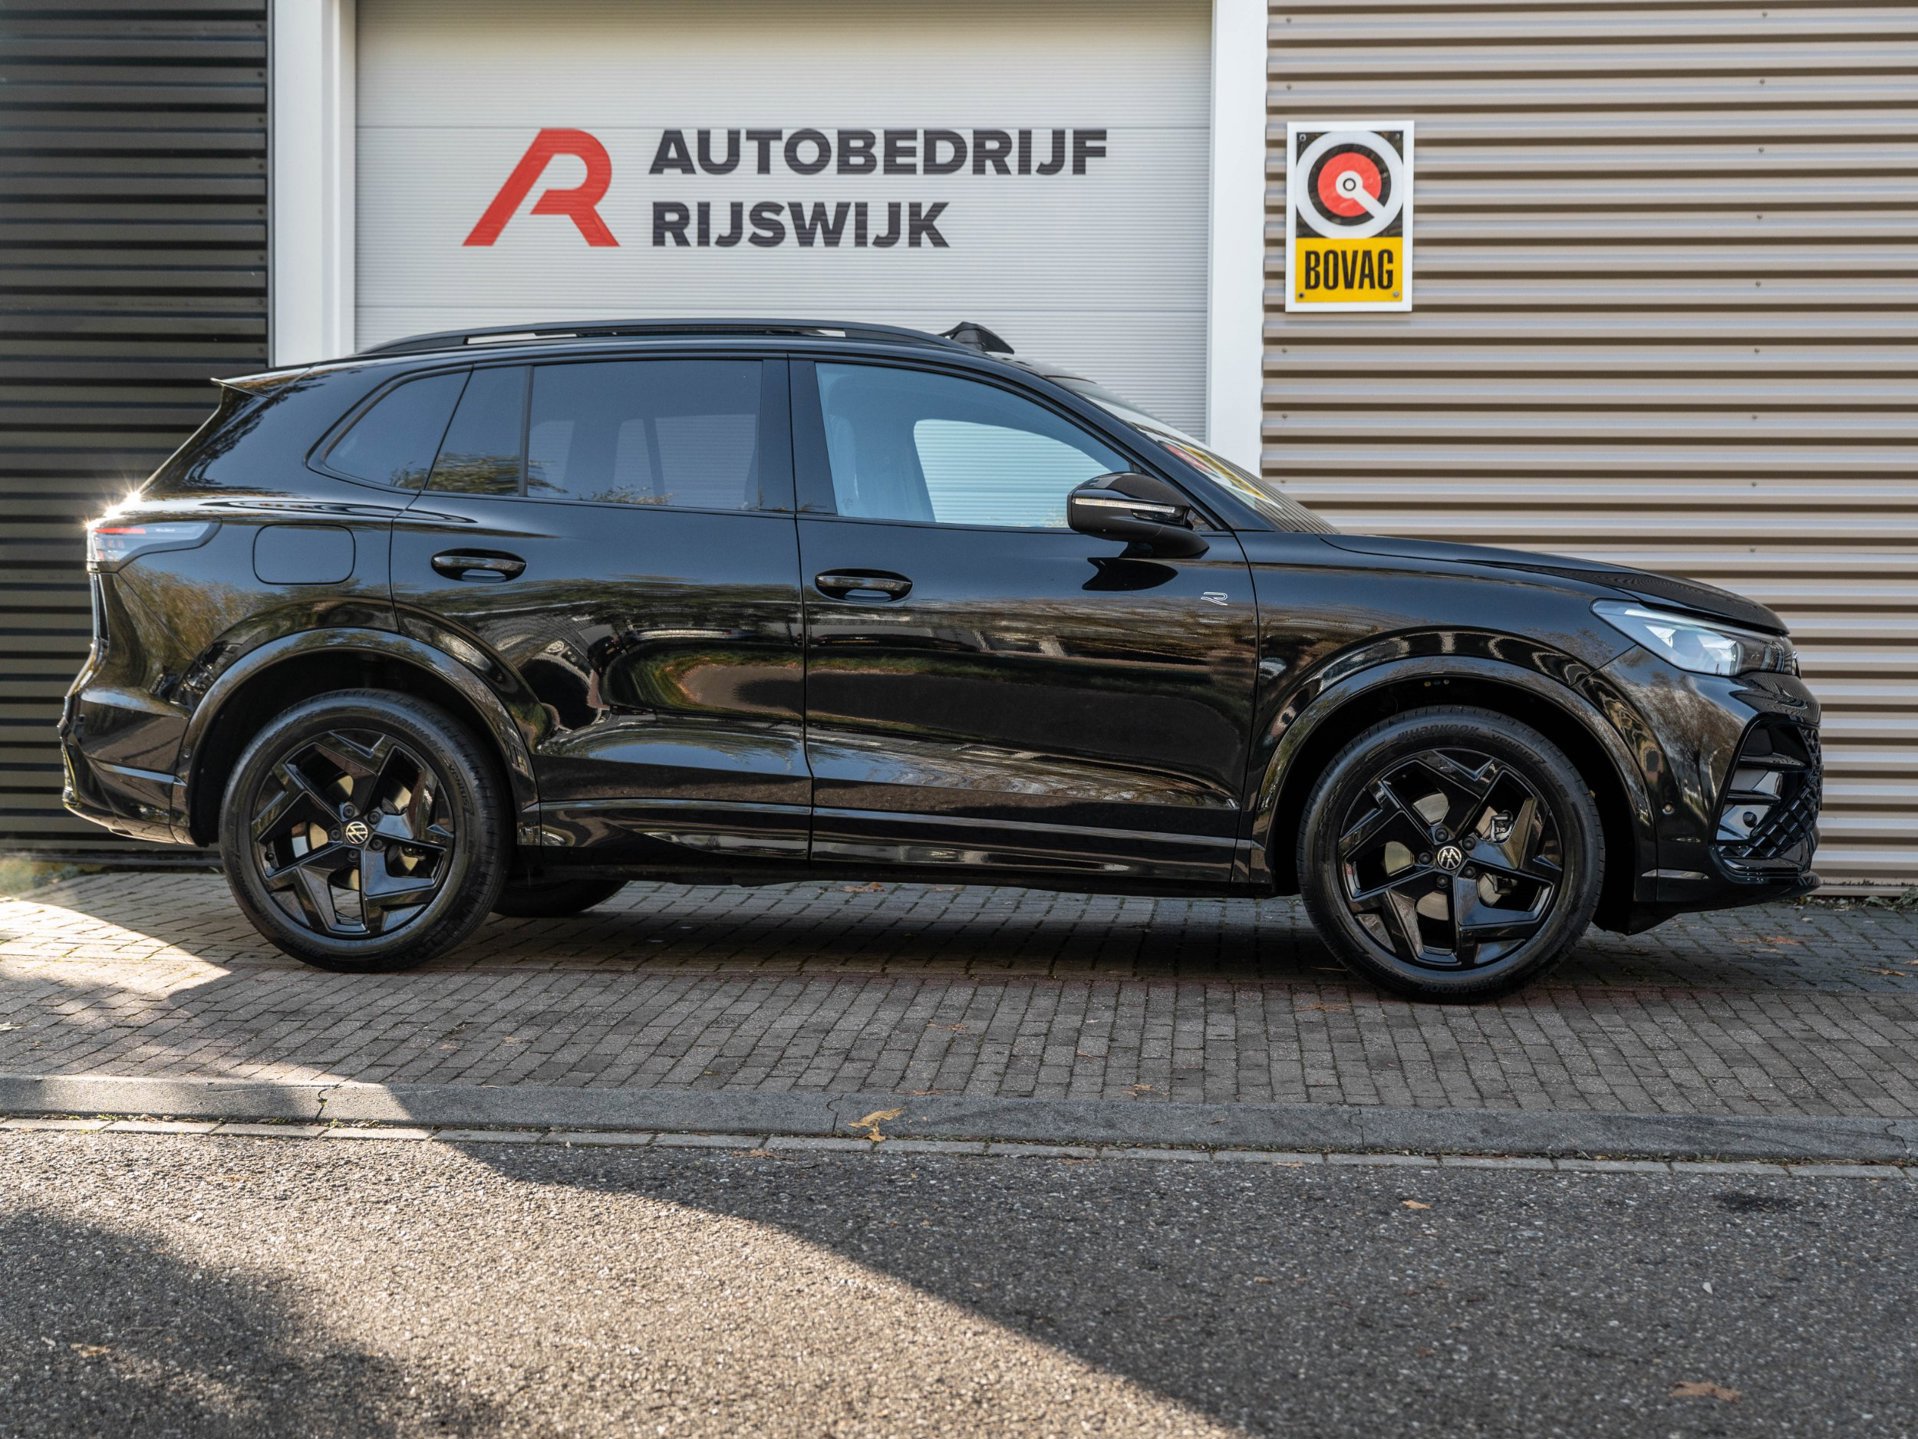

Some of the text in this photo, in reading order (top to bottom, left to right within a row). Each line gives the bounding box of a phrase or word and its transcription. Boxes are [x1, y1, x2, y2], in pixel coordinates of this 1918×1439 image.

[648, 128, 1108, 176] AUTOBEDRIJF
[652, 201, 950, 248] RIJSWIJK
[1304, 249, 1394, 290] BOVAG
